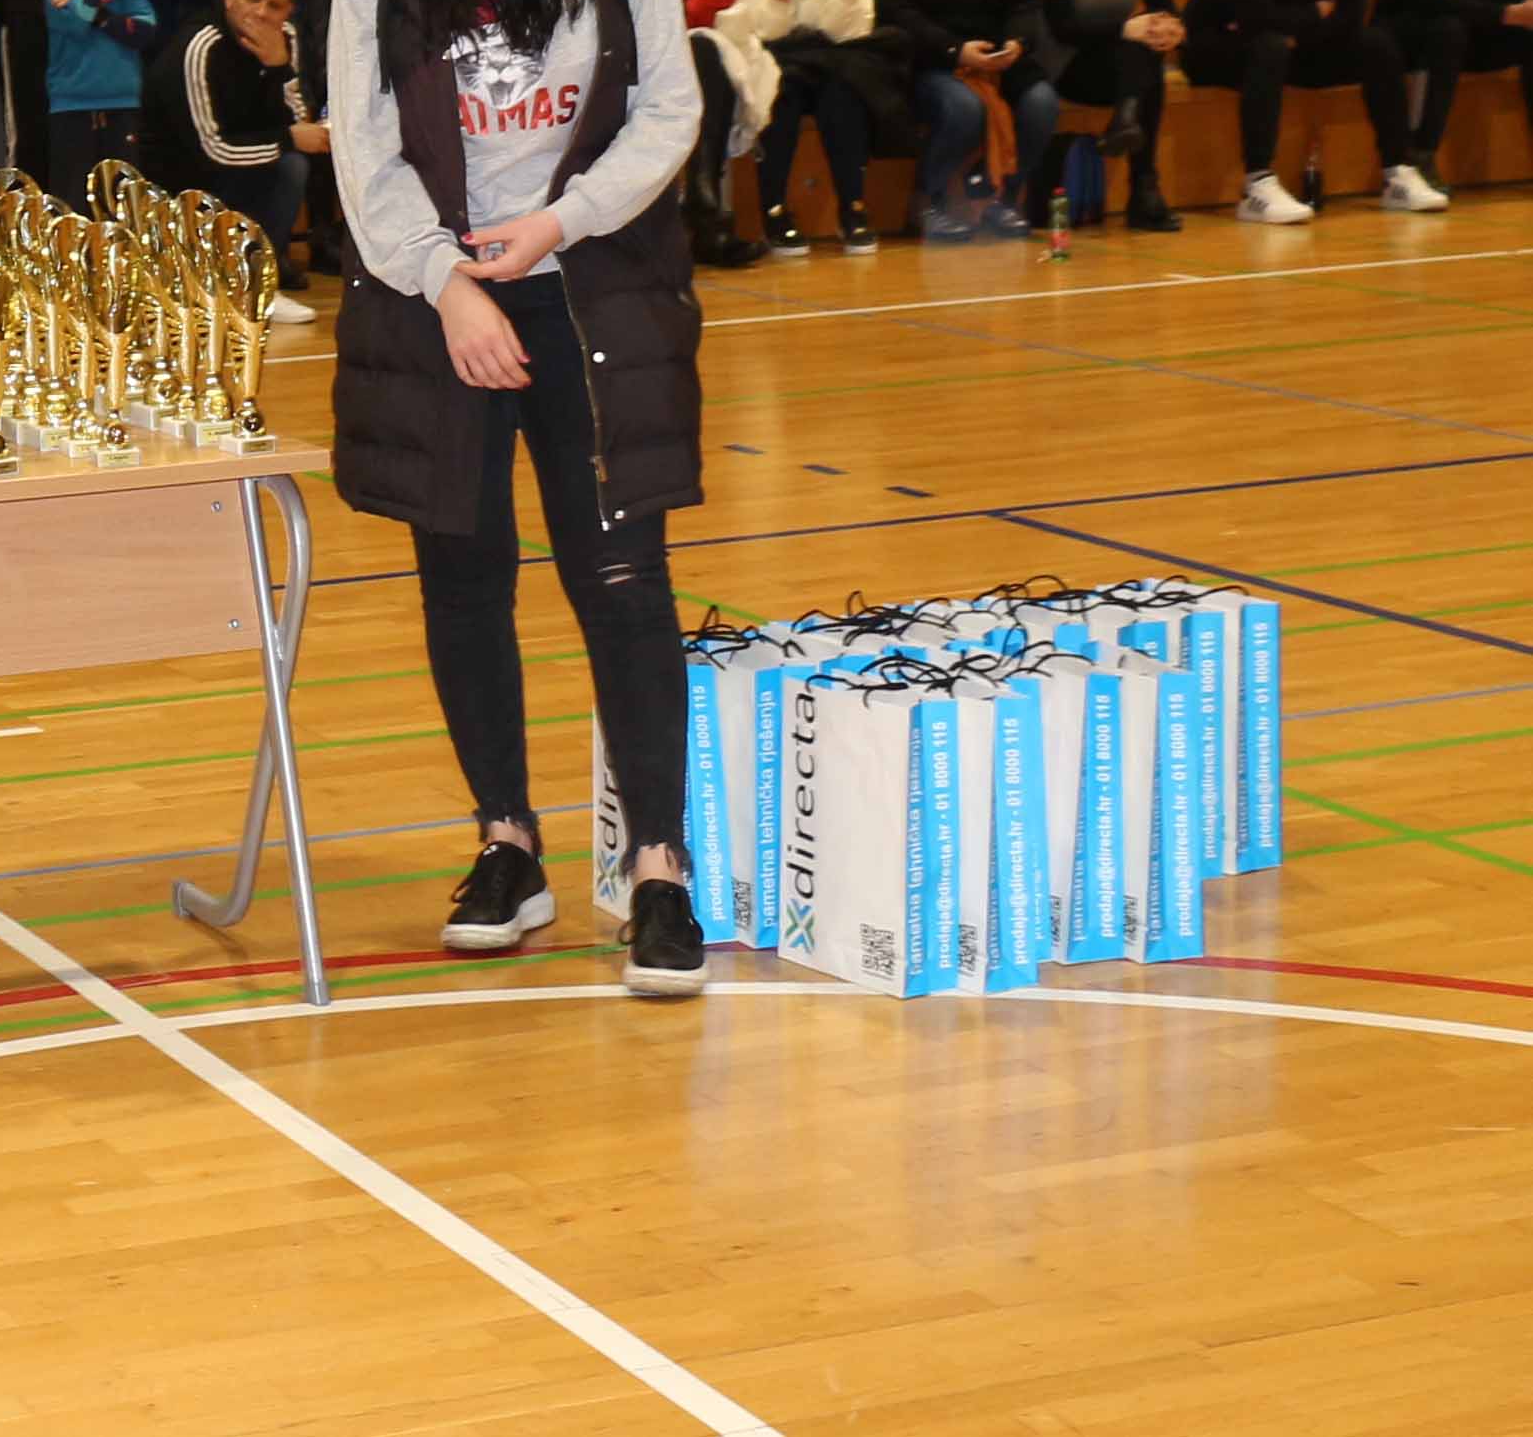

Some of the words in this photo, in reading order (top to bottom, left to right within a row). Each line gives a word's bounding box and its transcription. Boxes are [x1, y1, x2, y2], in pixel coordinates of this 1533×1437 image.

[457, 84, 580, 137] ATMAS
[698, 753, 714, 769] 01
[758, 690, 777, 762] rješenja
[757, 768, 774, 843] tehnička
[786, 692, 817, 900] directa
[1096, 765, 1111, 782] 01
[700, 780, 726, 922] prodaja@directa.hr
[759, 849, 776, 927] pametna
[1096, 795, 1116, 938] prodaja@directa.hr
